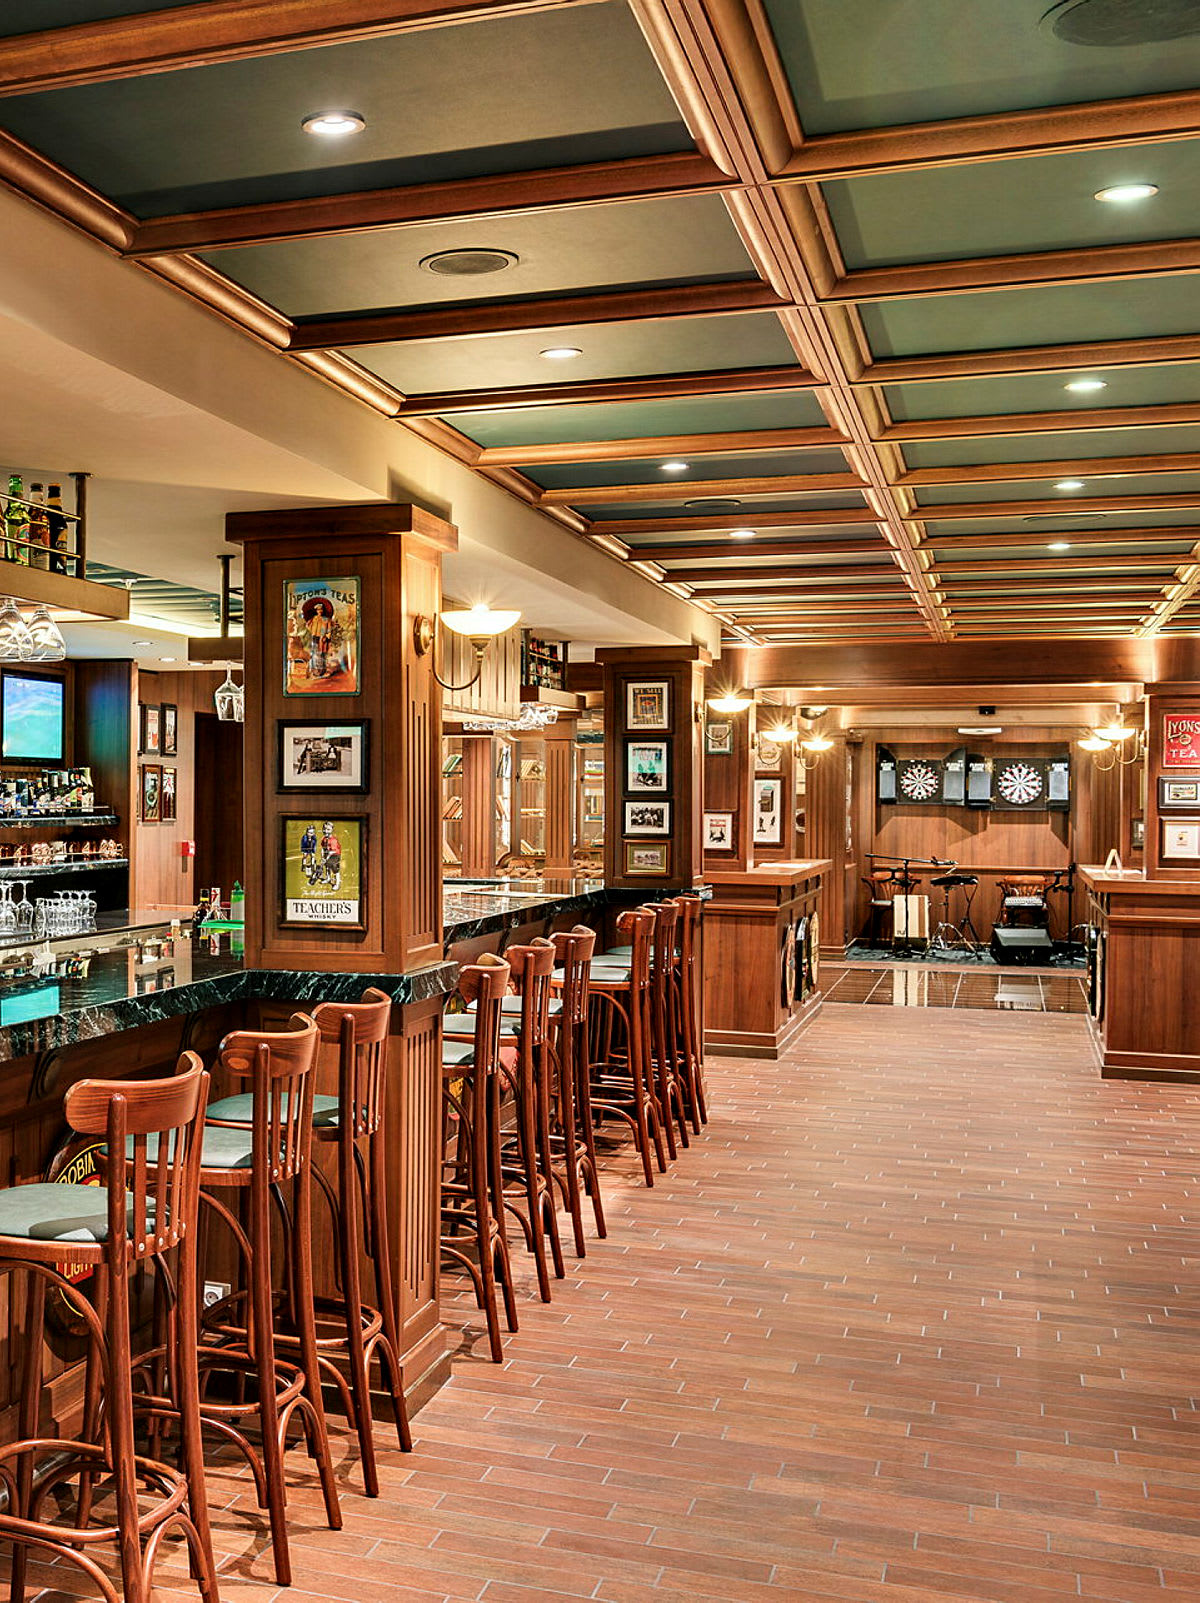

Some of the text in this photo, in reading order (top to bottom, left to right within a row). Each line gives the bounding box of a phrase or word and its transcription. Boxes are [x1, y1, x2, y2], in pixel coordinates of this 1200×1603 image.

[330, 589, 355, 605] TEAS
[1170, 749, 1198, 759] TEA
[292, 901, 352, 914] TEACHER'S
